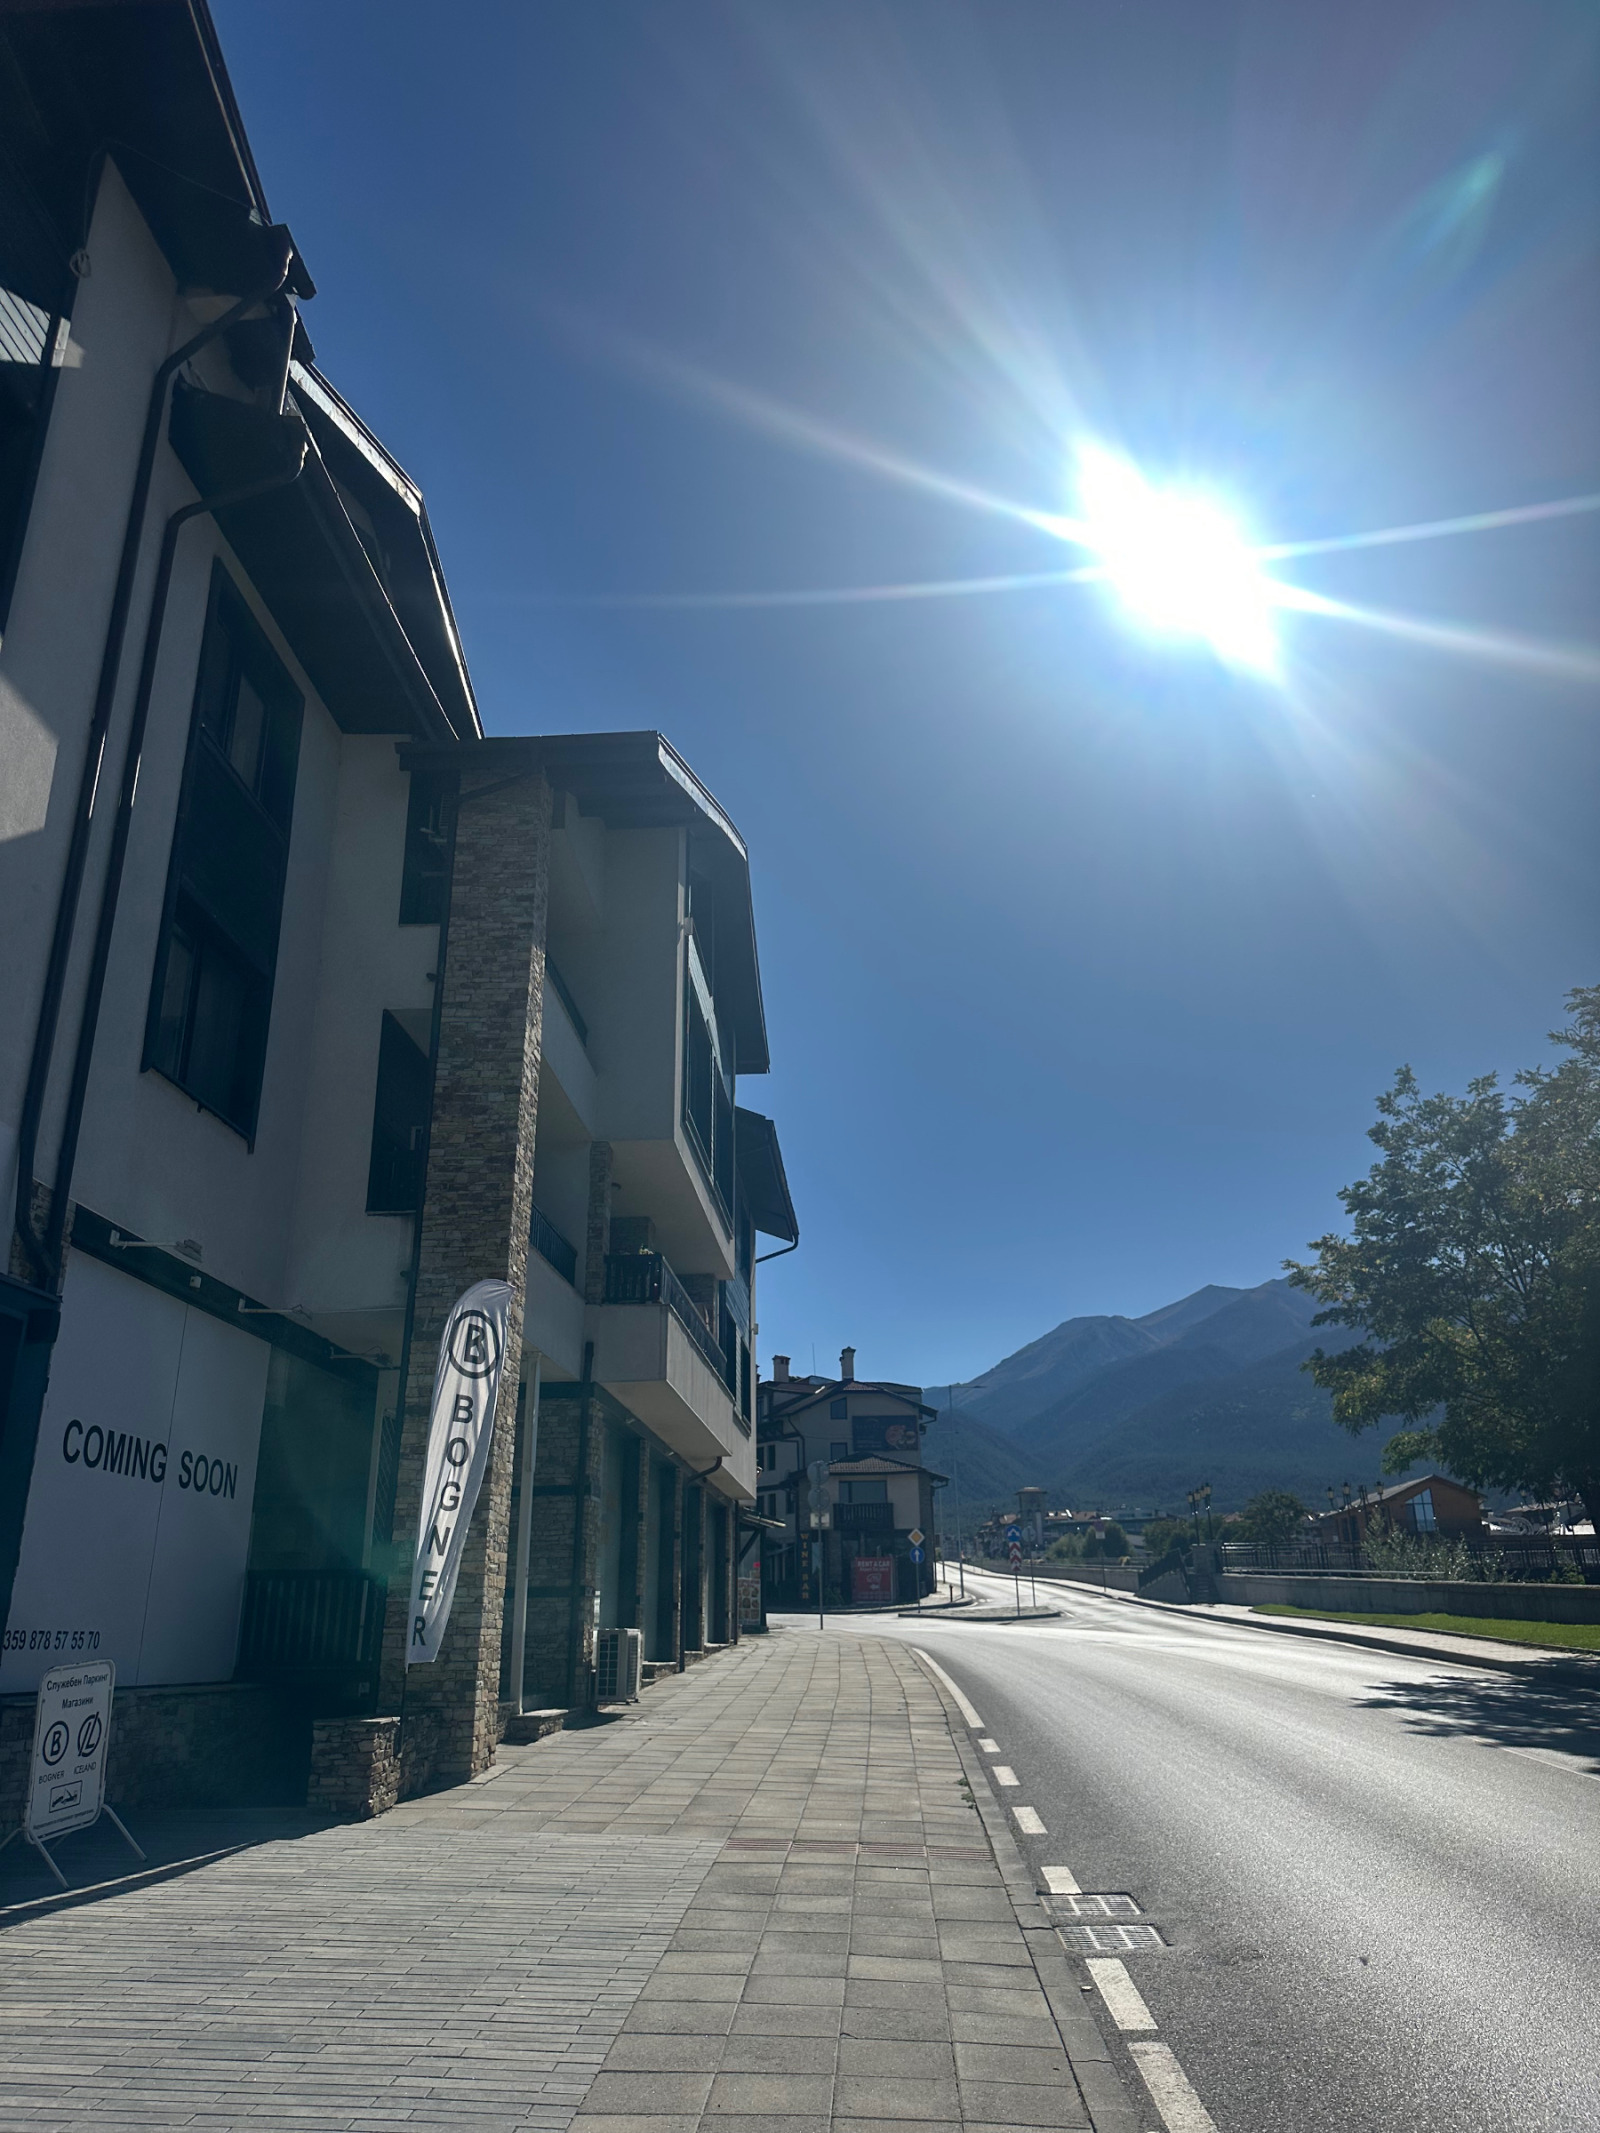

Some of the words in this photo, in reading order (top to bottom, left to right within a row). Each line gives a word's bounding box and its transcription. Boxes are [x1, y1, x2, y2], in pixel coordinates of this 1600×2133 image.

[464, 1323, 486, 1364] B
[62, 1419, 168, 1483] COMING
[178, 1450, 238, 1499] SOON
[412, 1393, 474, 1646] BOGNER
[3, 1630, 27, 1650] 359
[29, 1630, 51, 1650] 878
[54, 1631, 69, 1650] 57
[71, 1631, 85, 1650] 55
[87, 1631, 101, 1649] 70
[46, 1676, 82, 1692] Служебен
[83, 1673, 109, 1687] Паркинг
[62, 1697, 94, 1709] Магазини
[38, 1770, 65, 1784] BOGNER
[74, 1761, 97, 1775] ICELAND
